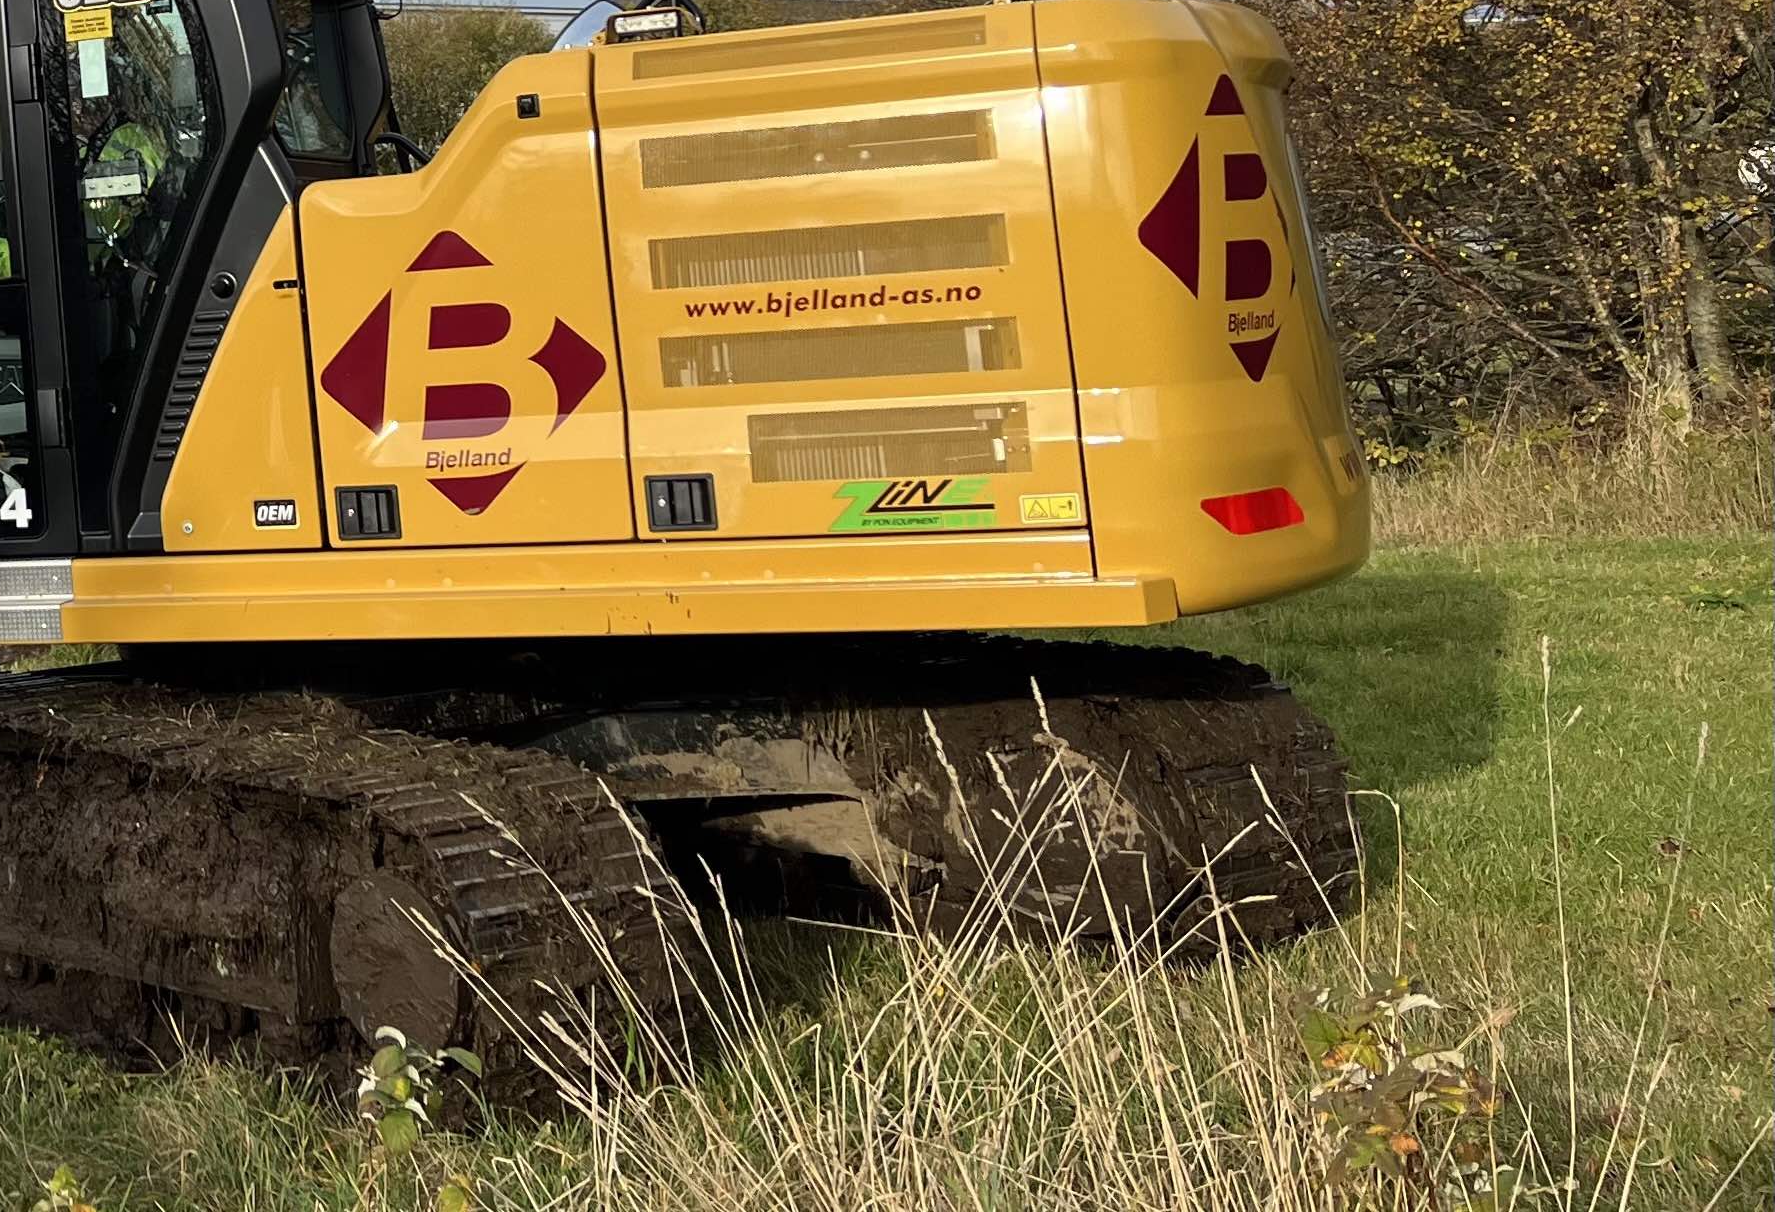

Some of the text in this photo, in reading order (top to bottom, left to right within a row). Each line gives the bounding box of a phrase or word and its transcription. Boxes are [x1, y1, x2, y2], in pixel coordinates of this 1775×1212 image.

[685, 285, 981, 317] www.bjelland-as.no
[1228, 309, 1275, 336] Bjelland
[425, 448, 511, 472] Bjelland
[257, 504, 294, 522] OEM
